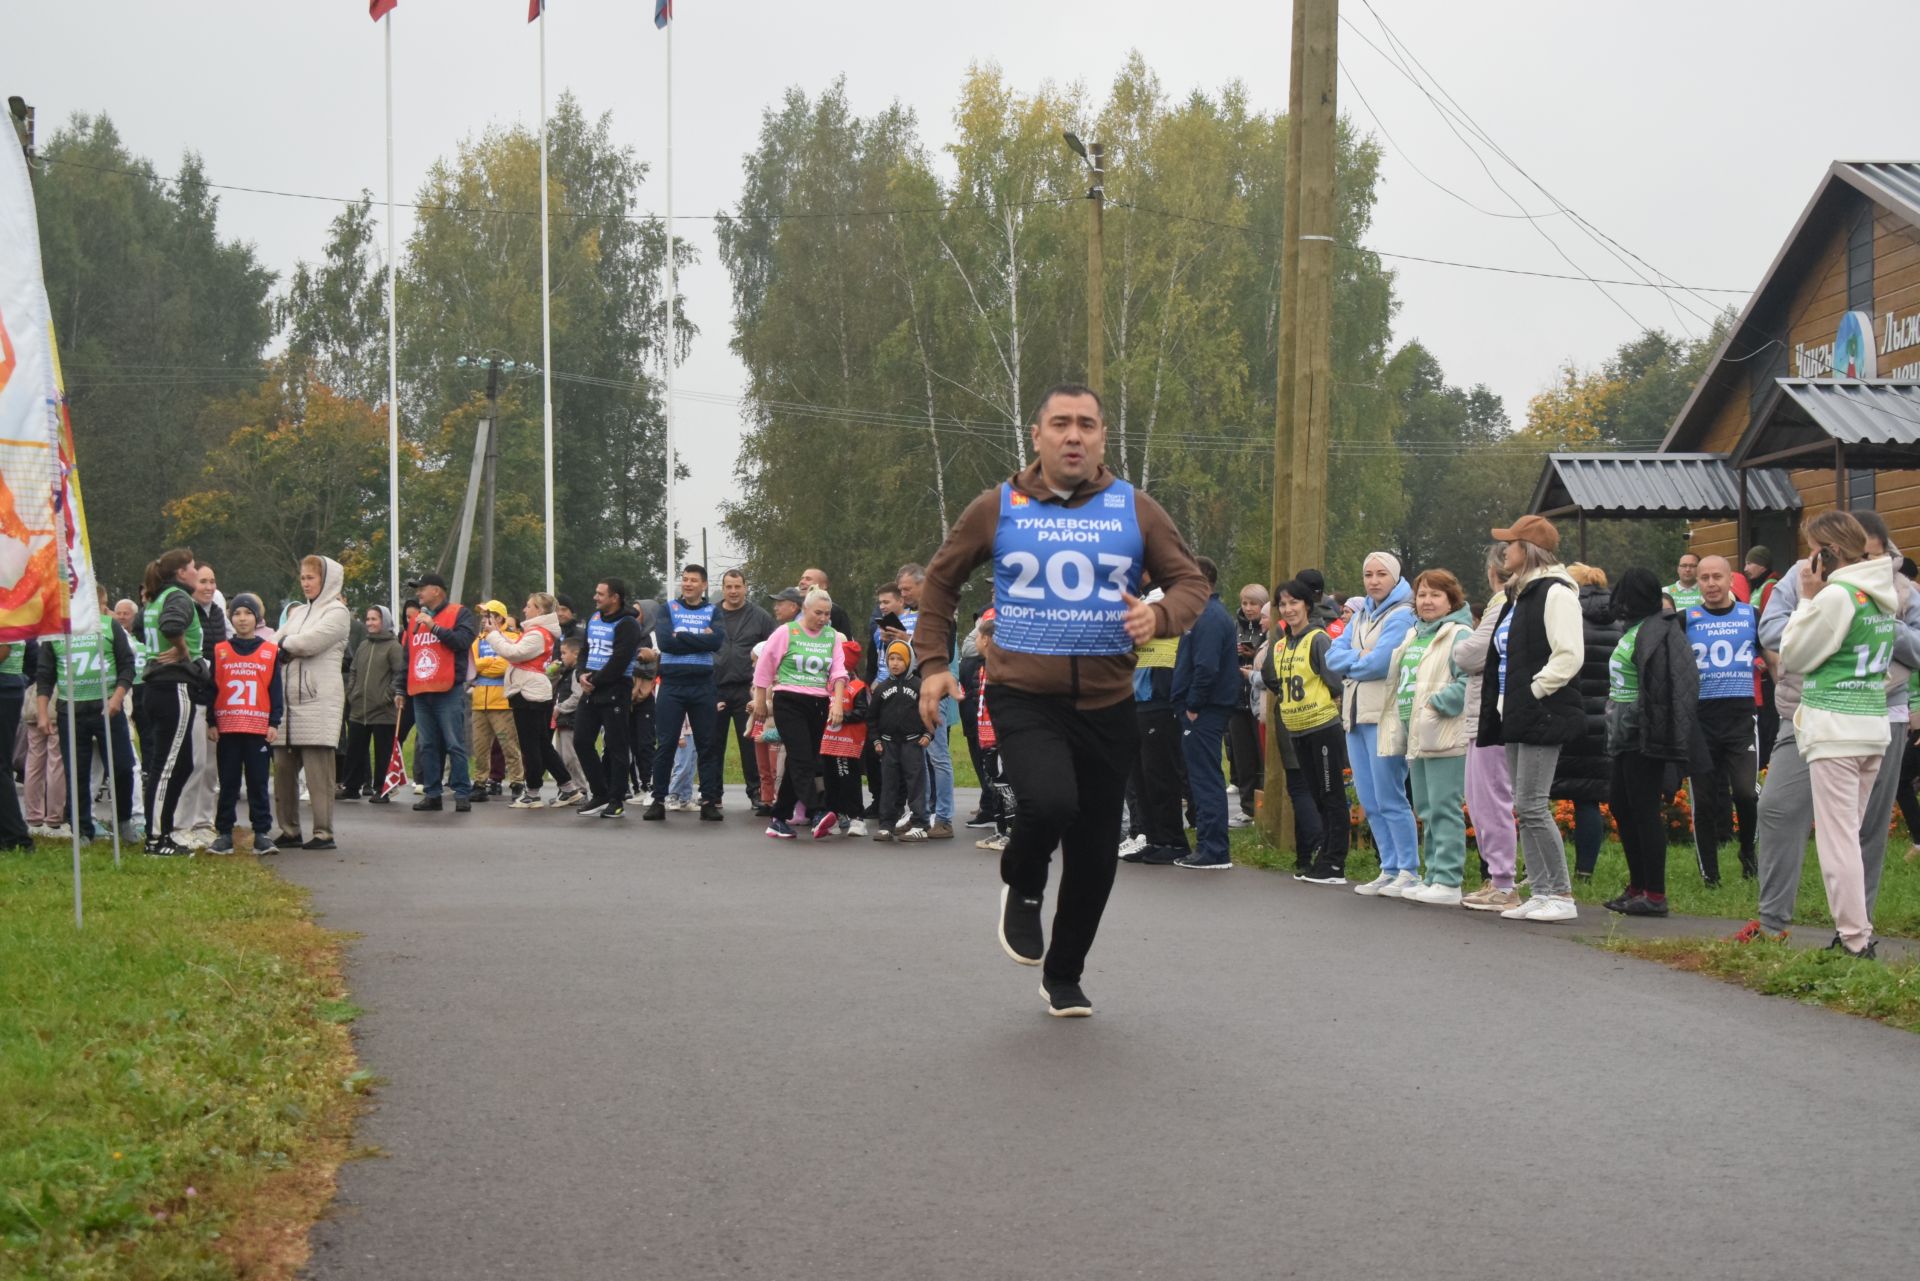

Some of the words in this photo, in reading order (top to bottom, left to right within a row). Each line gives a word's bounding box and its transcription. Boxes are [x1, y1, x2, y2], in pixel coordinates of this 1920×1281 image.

[1016, 518, 1122, 532] ТУКАЕВСКИЙ
[1038, 529, 1100, 543] РАЙОН
[1001, 550, 1133, 602] 203
[1695, 620, 1749, 631] ТУКАЕВСКИЙ
[1707, 628, 1738, 636] РАЙОН
[1691, 639, 1753, 669] 204
[226, 679, 257, 706] 21
